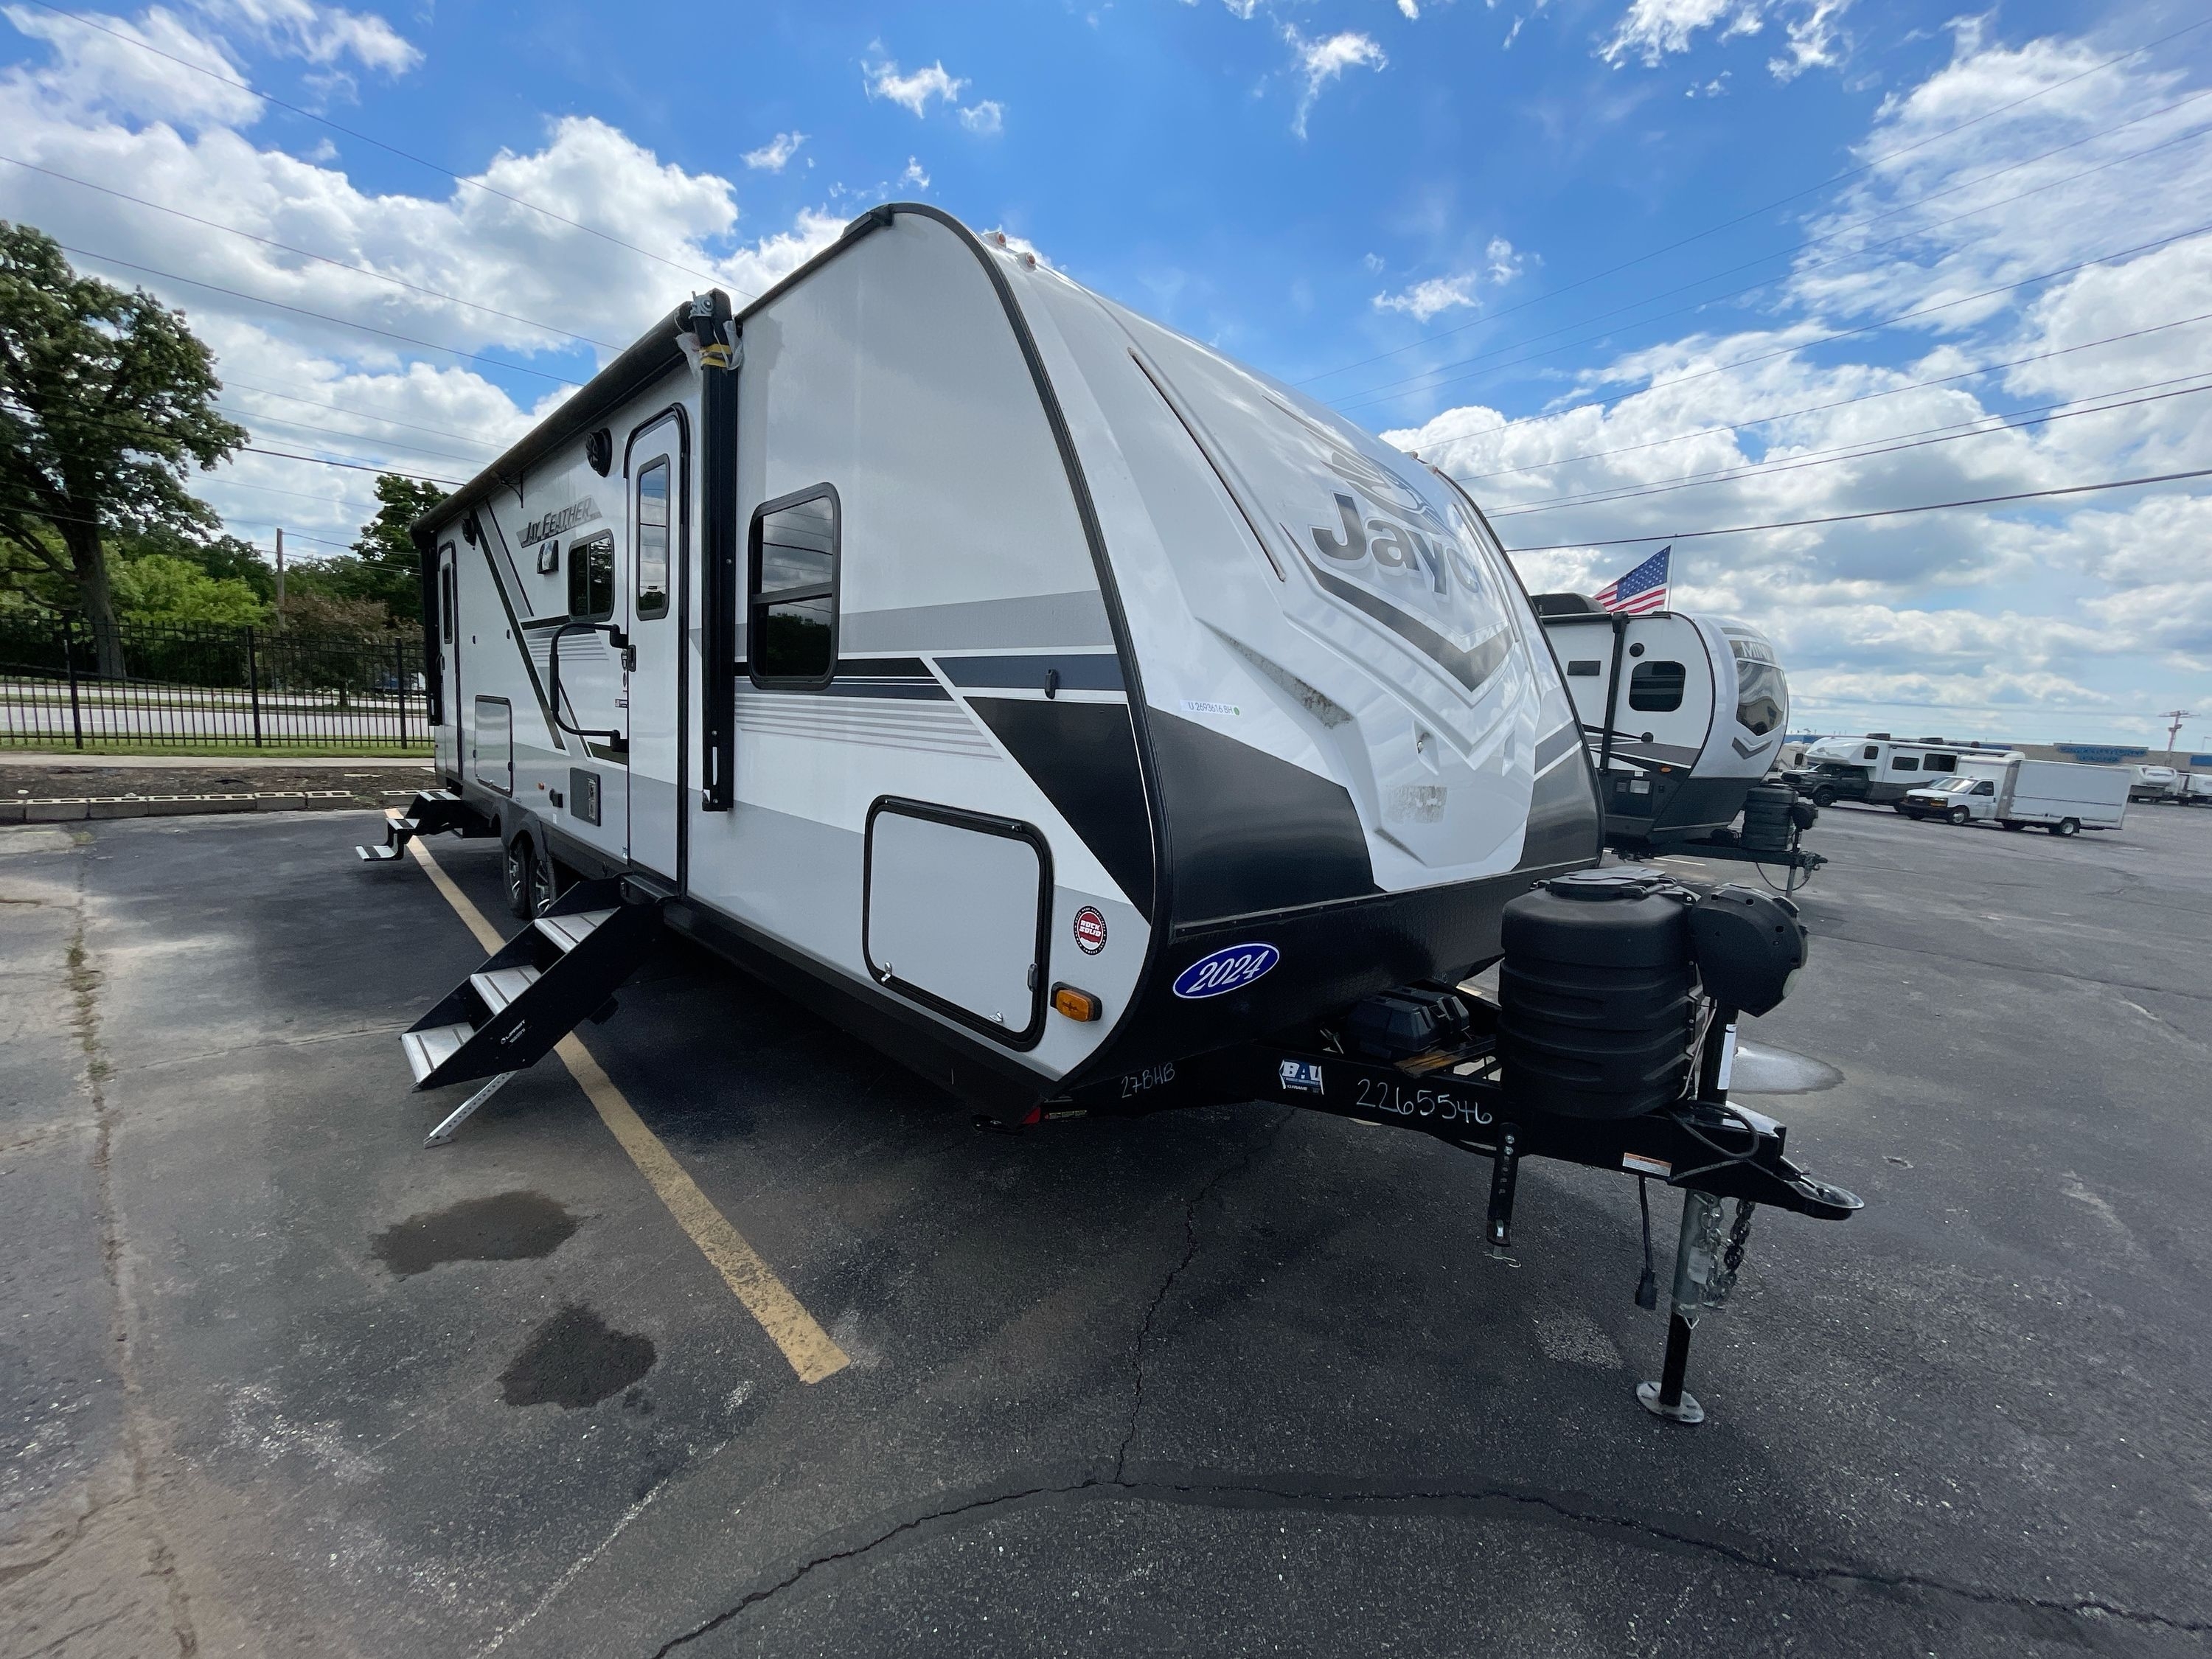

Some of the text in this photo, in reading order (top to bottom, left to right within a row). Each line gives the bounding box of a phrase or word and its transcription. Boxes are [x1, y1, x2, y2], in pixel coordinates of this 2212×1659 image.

[521, 497, 593, 544] JAY FEATHER
[1310, 490, 1481, 596] Jayc
[1079, 925, 1102, 937] SOLID
[1080, 919, 1101, 931] ROCK
[1186, 950, 1270, 994] 2024
[1121, 1062, 1175, 1099] 27BHB
[1356, 1078, 1493, 1125] 2265546
